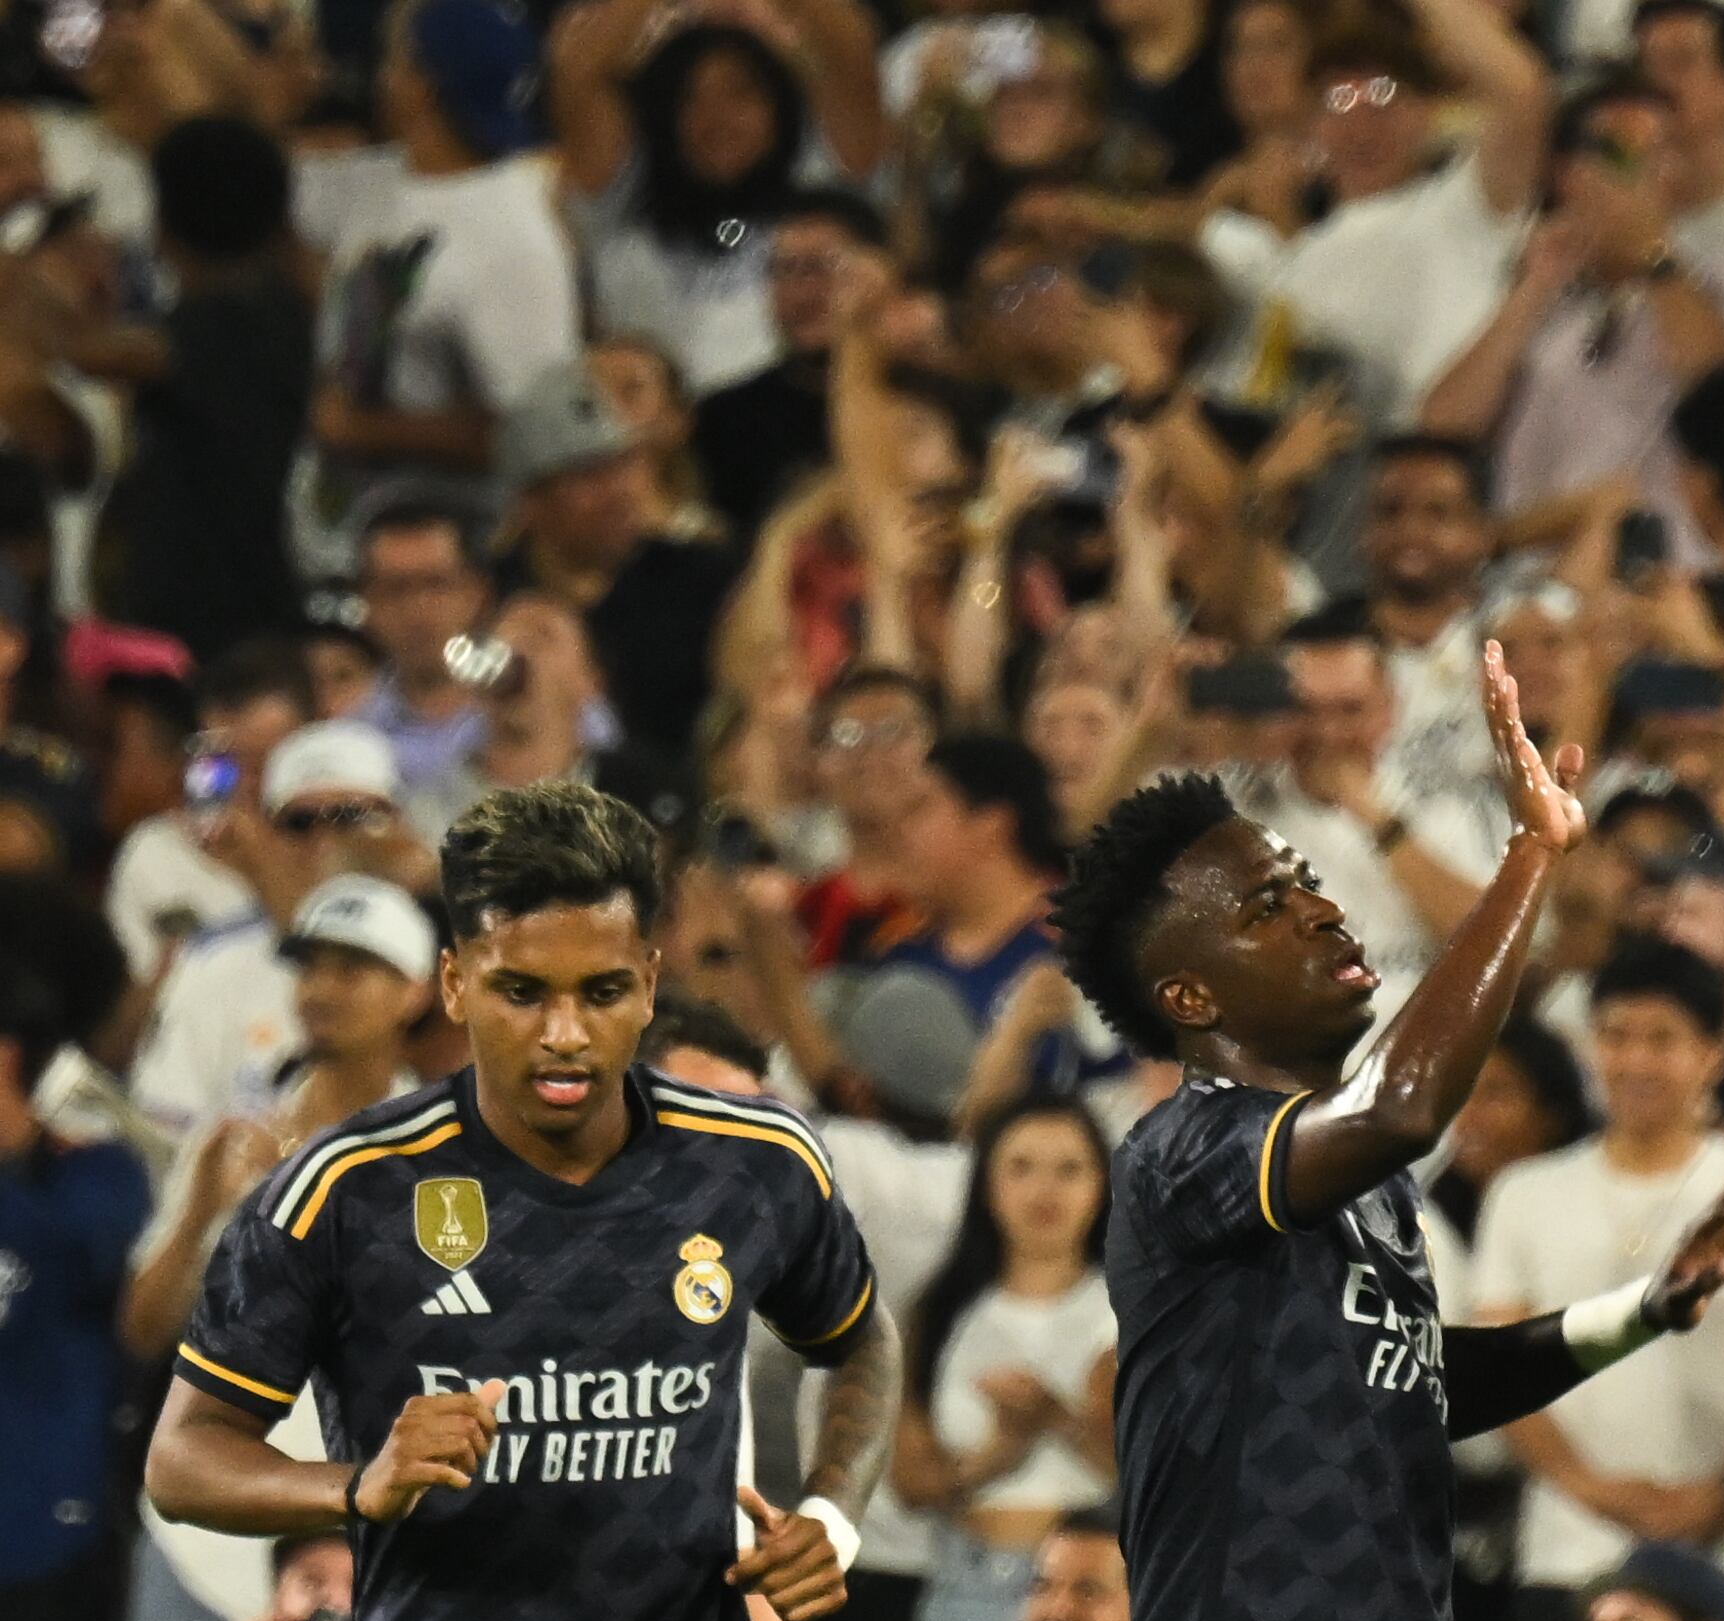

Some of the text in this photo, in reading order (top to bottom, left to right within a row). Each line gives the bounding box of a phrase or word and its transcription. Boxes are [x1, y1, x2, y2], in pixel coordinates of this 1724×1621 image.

[437, 1234, 468, 1247] FIFA
[484, 1425, 678, 1484] LY BETTER
